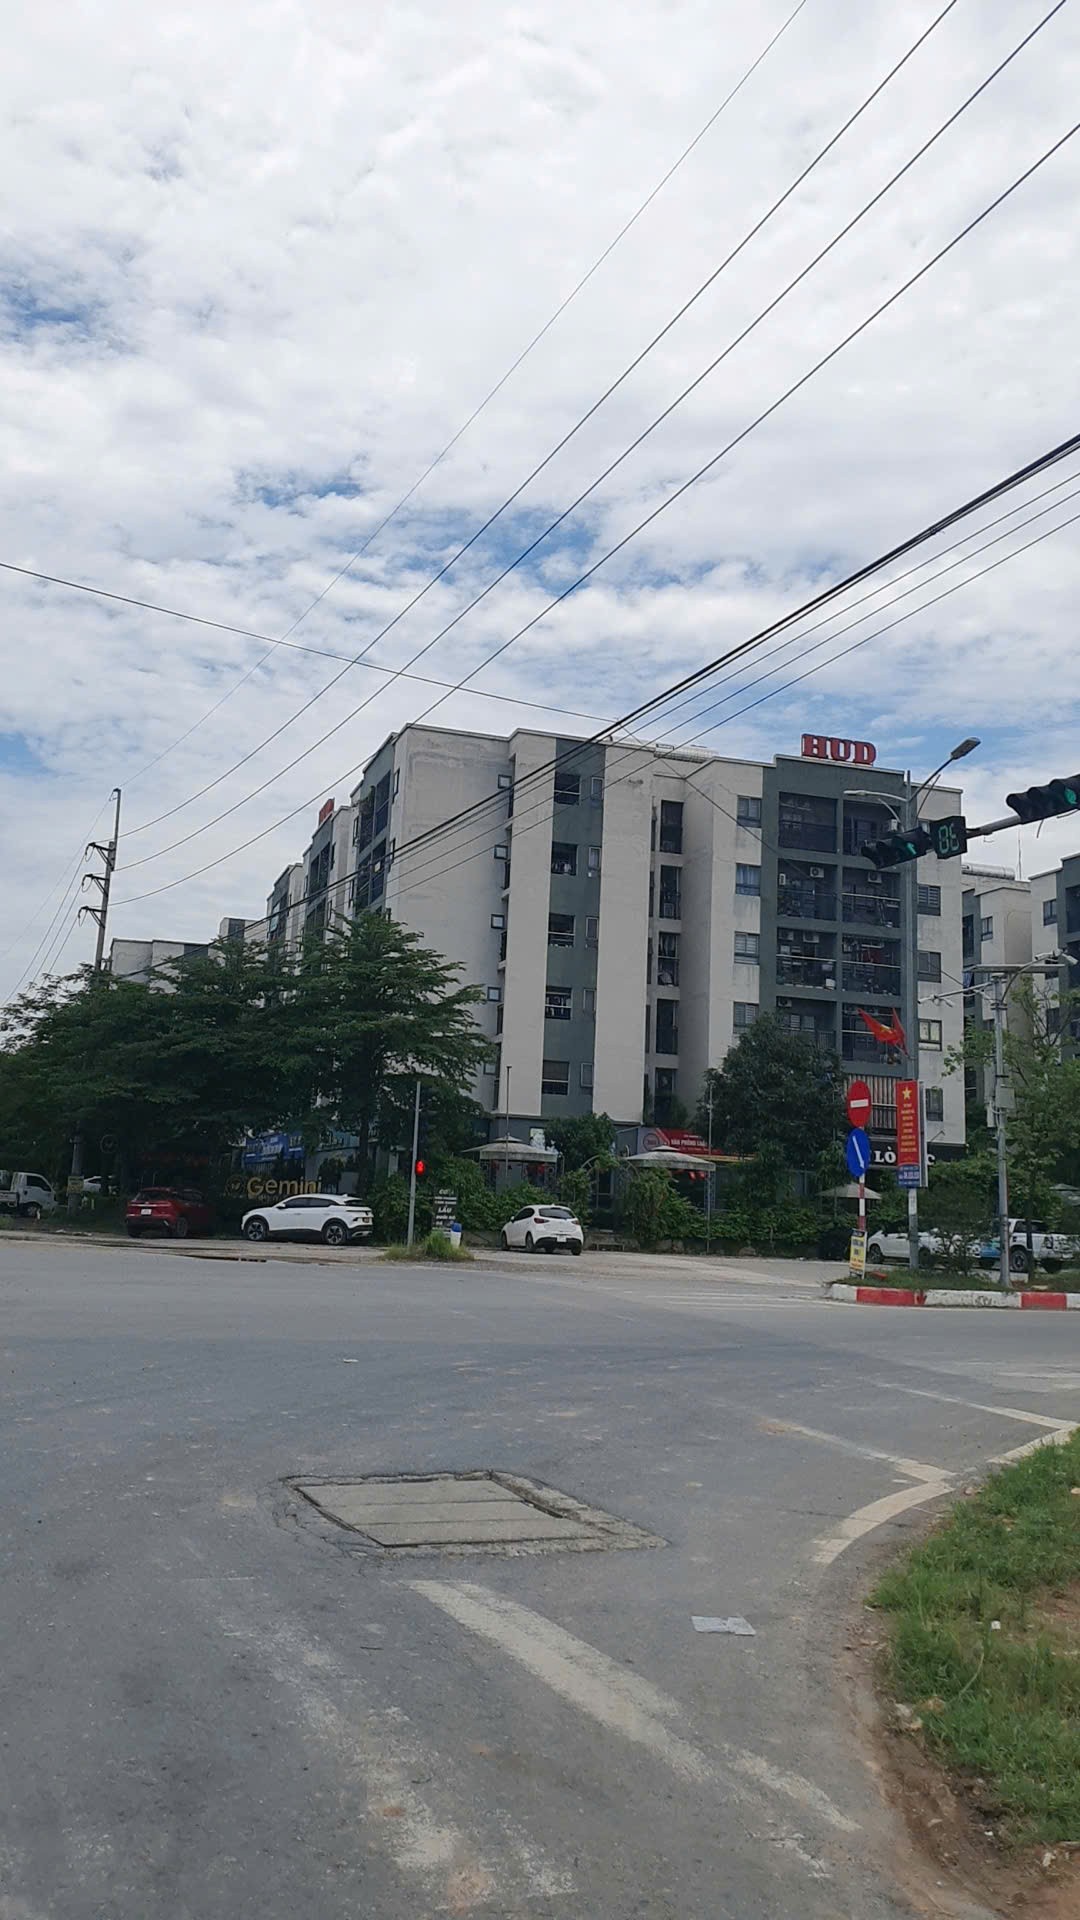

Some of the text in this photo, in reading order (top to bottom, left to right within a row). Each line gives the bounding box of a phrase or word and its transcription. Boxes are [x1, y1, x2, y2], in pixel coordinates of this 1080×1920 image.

[801, 733, 876, 766] HUD
[873, 1146, 897, 1163] LÒ
[246, 1176, 322, 1196] Gemini
